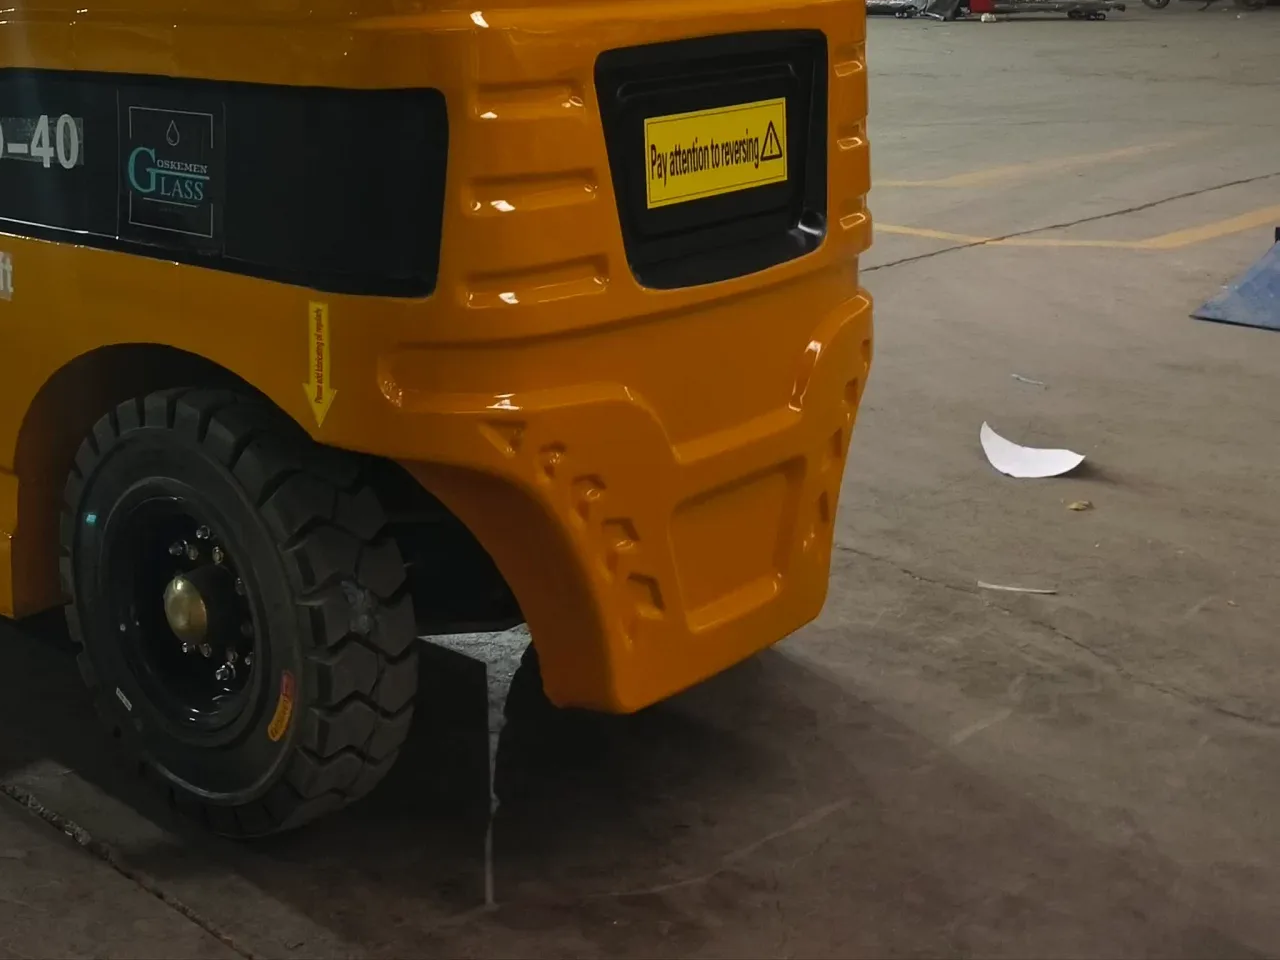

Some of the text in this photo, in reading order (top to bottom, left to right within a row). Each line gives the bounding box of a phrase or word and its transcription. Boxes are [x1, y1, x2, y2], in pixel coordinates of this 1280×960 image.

[650, 128, 759, 187] Pay attention to reversing
